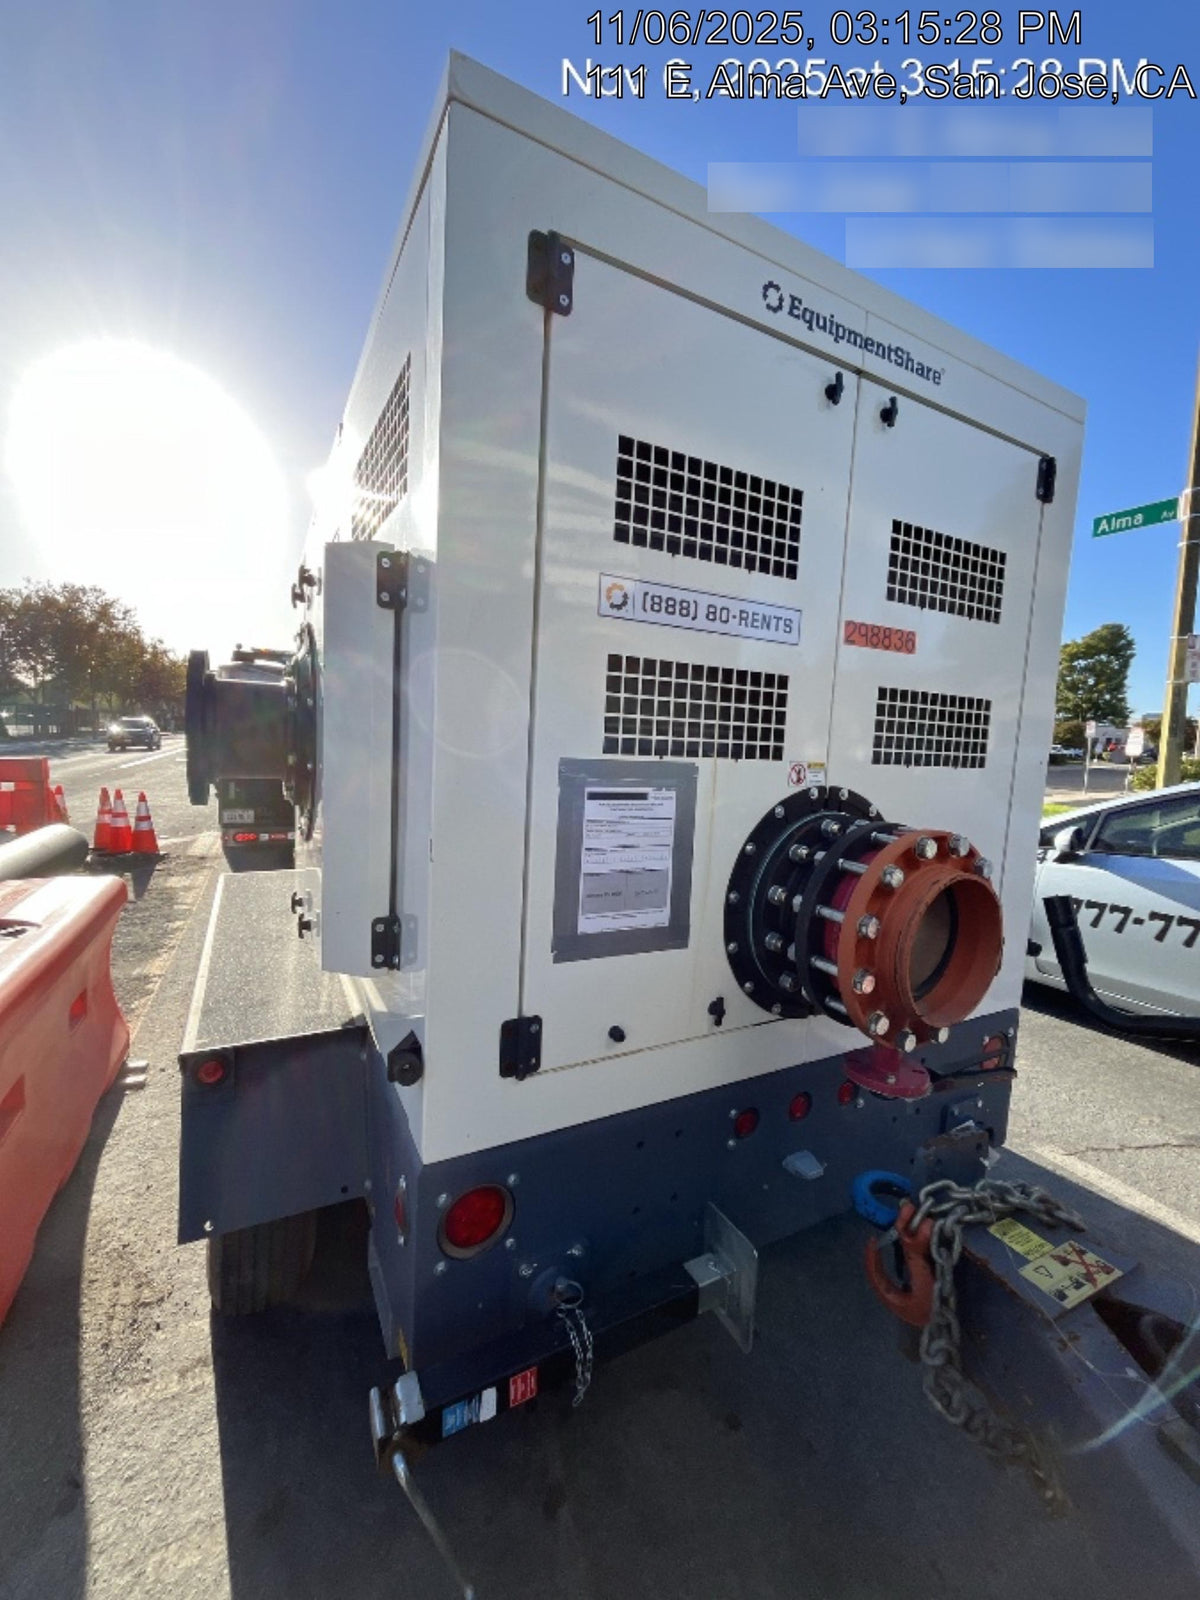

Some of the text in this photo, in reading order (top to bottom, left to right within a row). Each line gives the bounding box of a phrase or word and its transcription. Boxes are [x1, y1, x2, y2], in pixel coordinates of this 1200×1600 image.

[1097, 513, 1144, 534] Alma
[642, 591, 794, 635] (888) 80-RENTS
[844, 620, 917, 654] 298836
